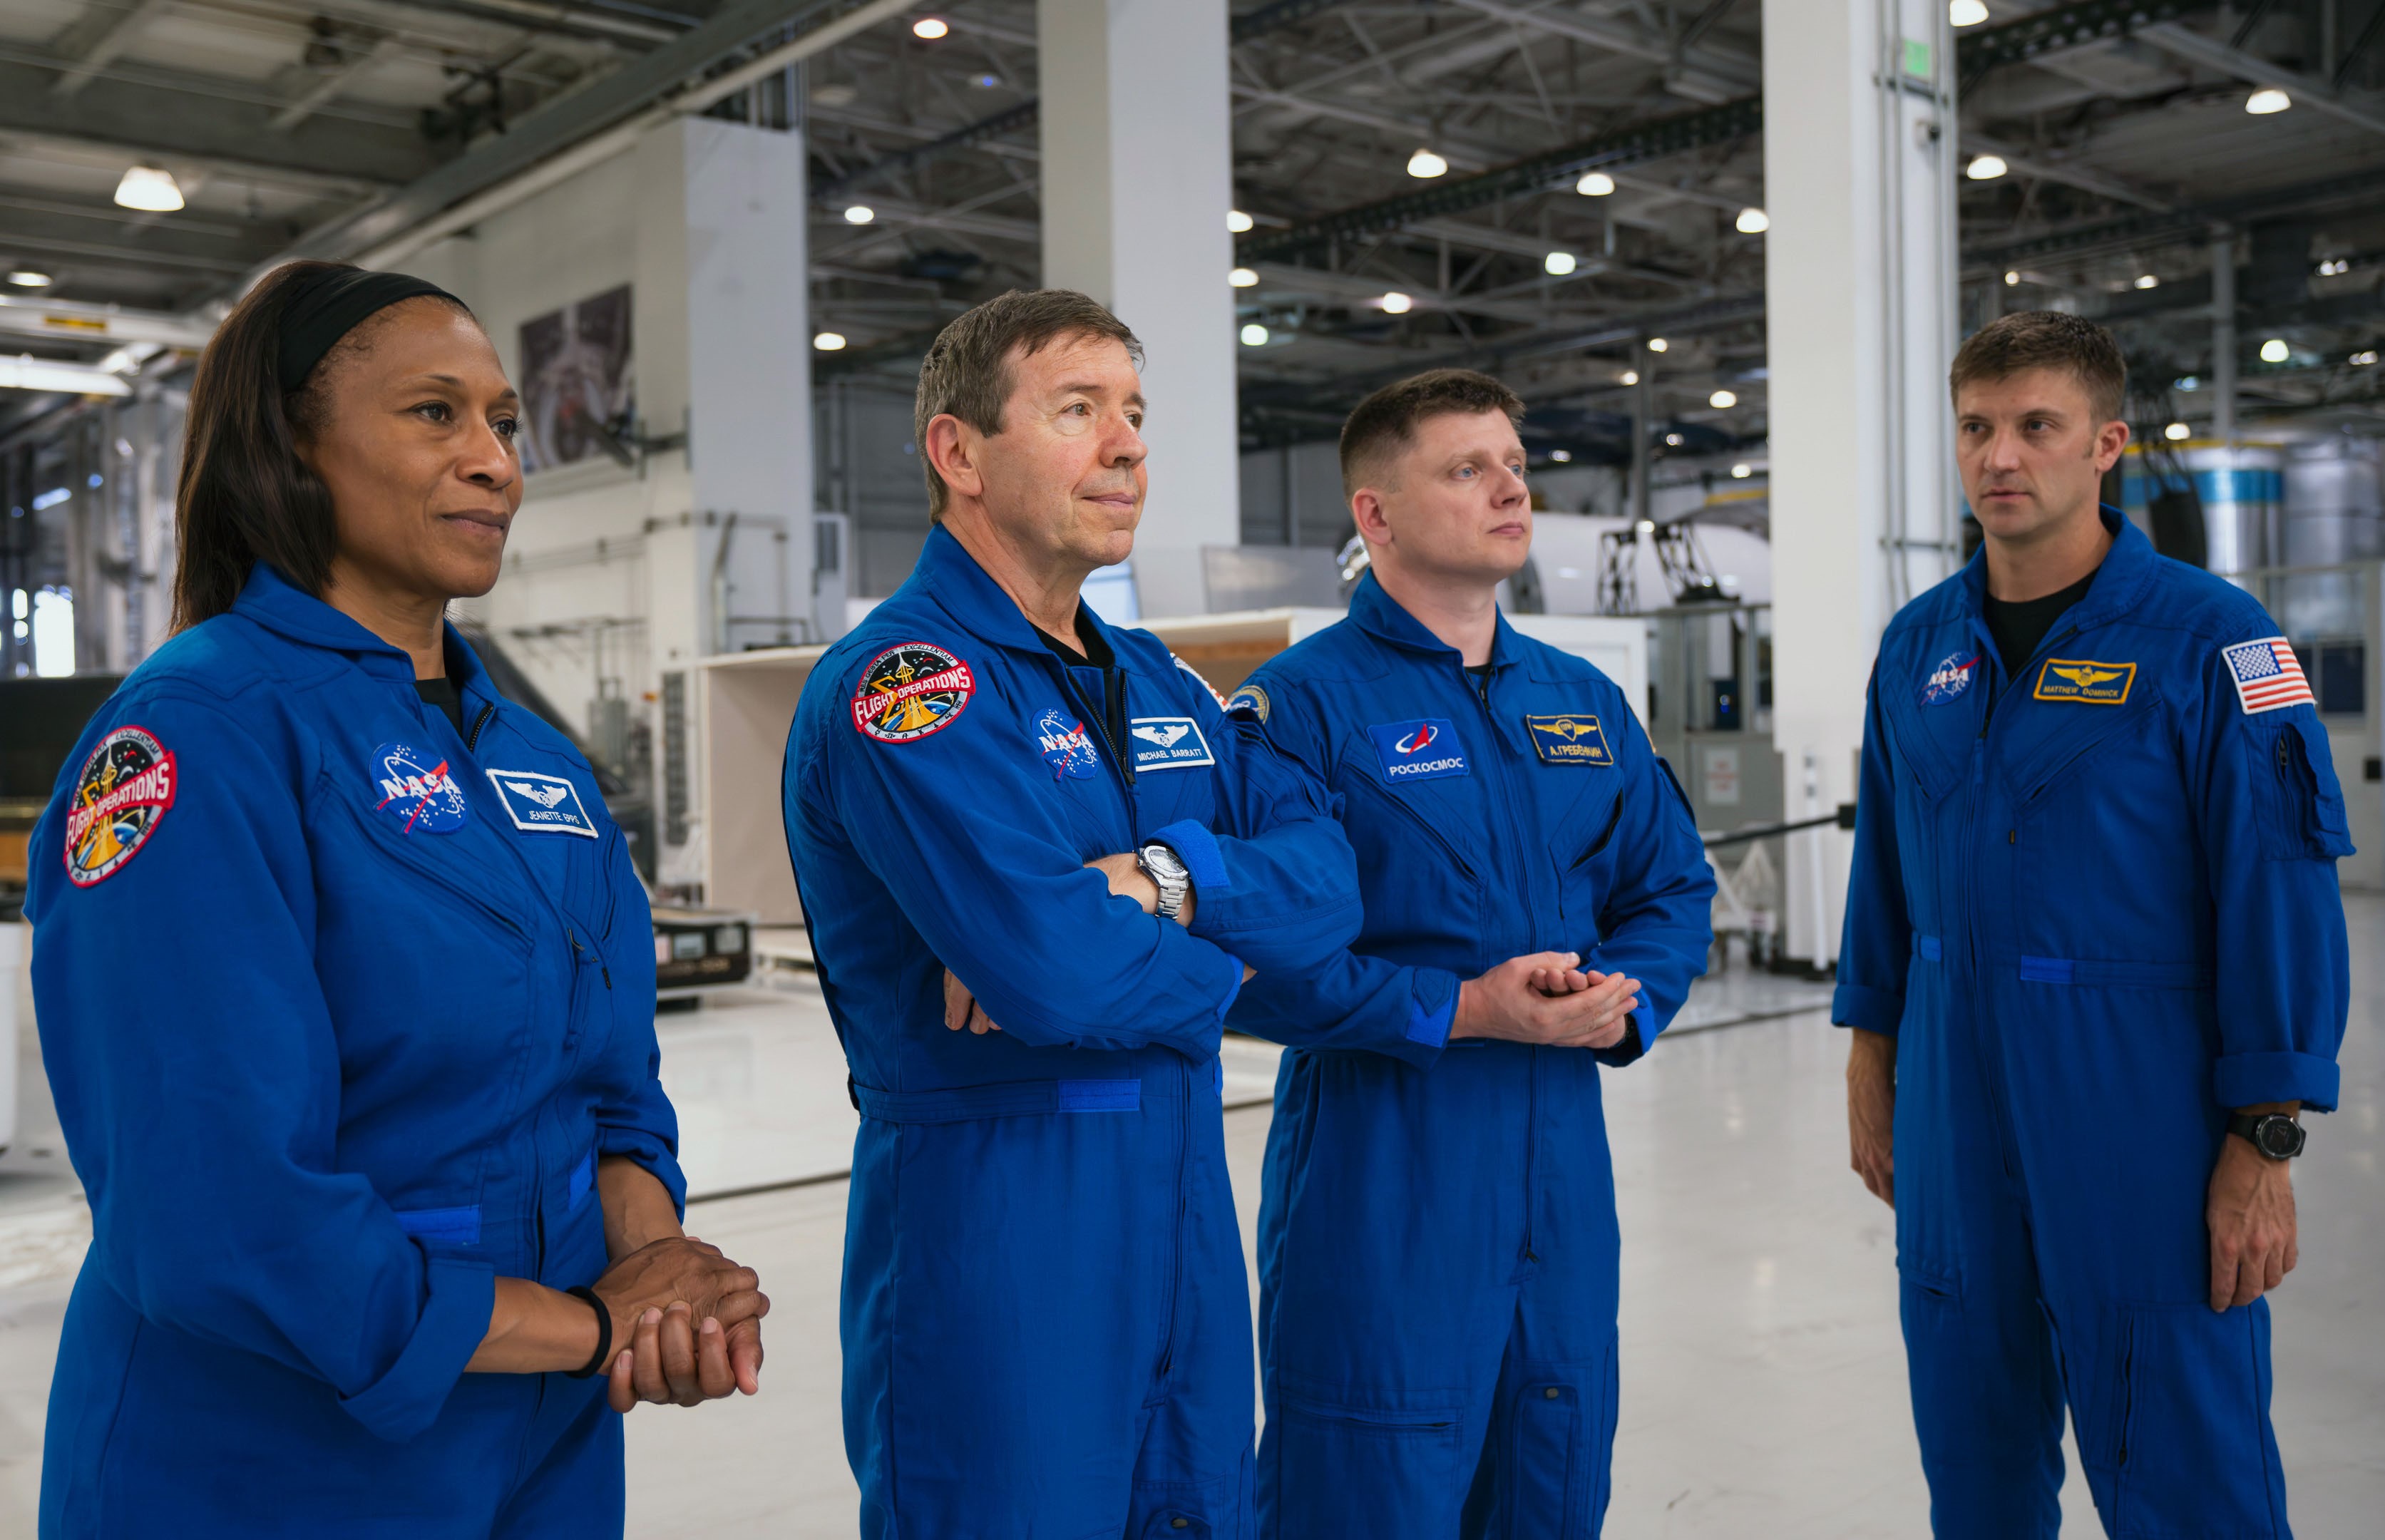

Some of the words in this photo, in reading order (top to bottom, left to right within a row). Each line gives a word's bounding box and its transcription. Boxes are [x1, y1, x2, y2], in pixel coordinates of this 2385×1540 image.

[866, 659, 882, 678] GESTA
[881, 650, 896, 661] PER
[904, 644, 954, 662] EXCELLENTIAM
[1928, 668, 1969, 687] NASA
[855, 690, 895, 726] FLIGHT
[898, 667, 970, 699] OPERATIONS
[1038, 733, 1094, 753] NASA
[1137, 750, 1169, 761] MICHAEL
[1170, 749, 1203, 758] BARRATT
[1389, 757, 1464, 776] РОСКОСМОС
[379, 774, 462, 801] NASA
[66, 806, 96, 853] FLIGHT
[96, 761, 170, 818] OPERATIONS
[529, 811, 563, 821] JEANETTE
[563, 813, 580, 825] EPPS
